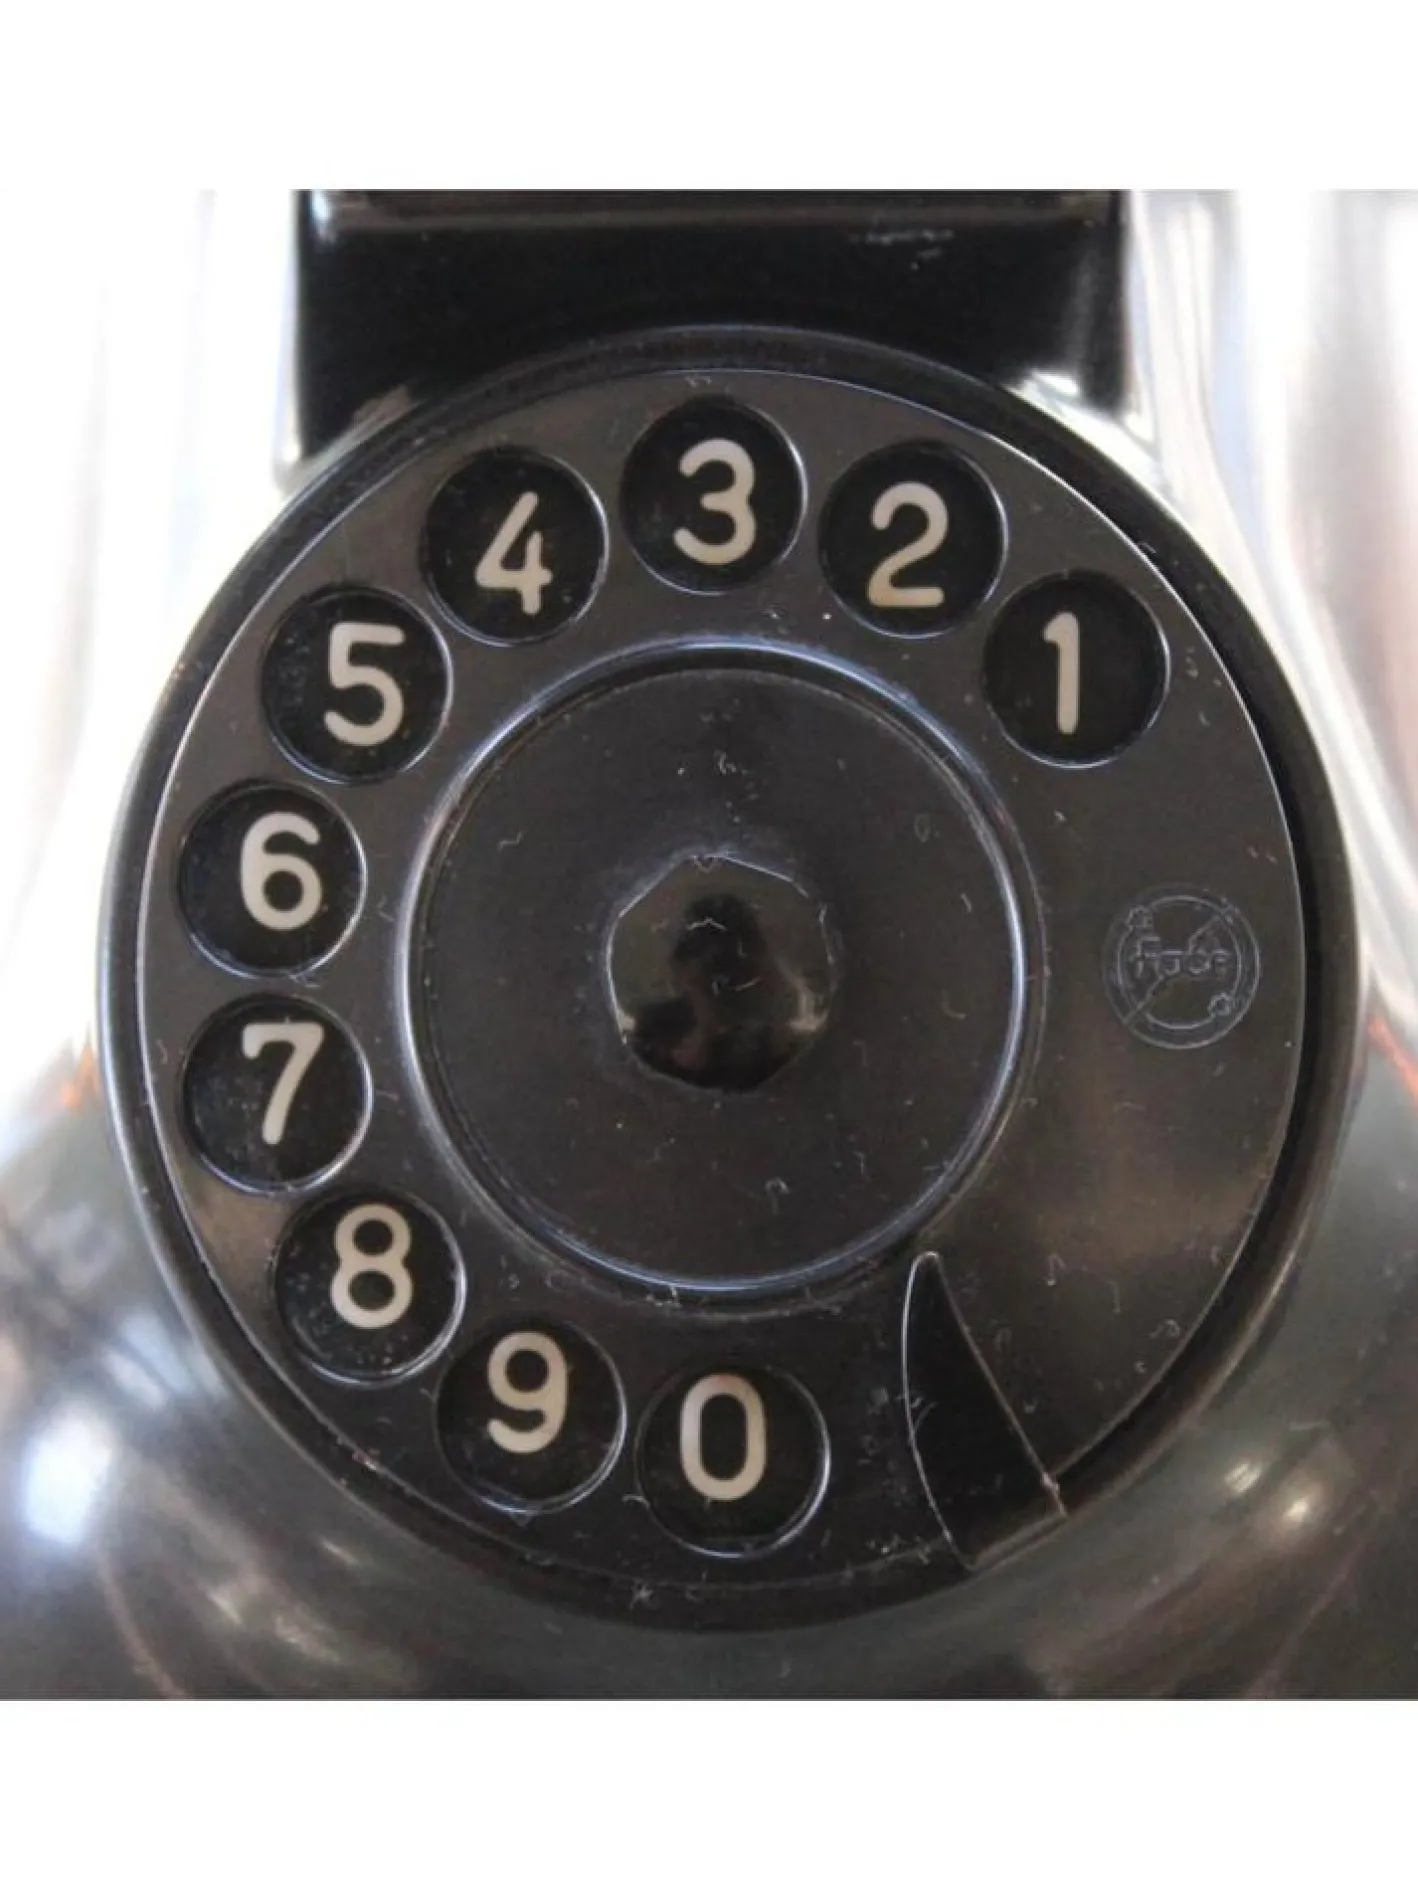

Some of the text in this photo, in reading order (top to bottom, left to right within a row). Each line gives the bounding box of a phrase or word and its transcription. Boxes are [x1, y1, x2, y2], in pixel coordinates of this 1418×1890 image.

[476, 493, 551, 613] 4
[675, 440, 755, 563] 3
[869, 483, 947, 605] 2
[325, 623, 403, 746] 5
[1045, 613, 1079, 732] 1
[241, 813, 321, 929] 6
[243, 1021, 325, 1144] 7
[330, 1206, 412, 1329] 8
[489, 1333, 566, 1452] 9
[681, 1377, 764, 1500] 0
